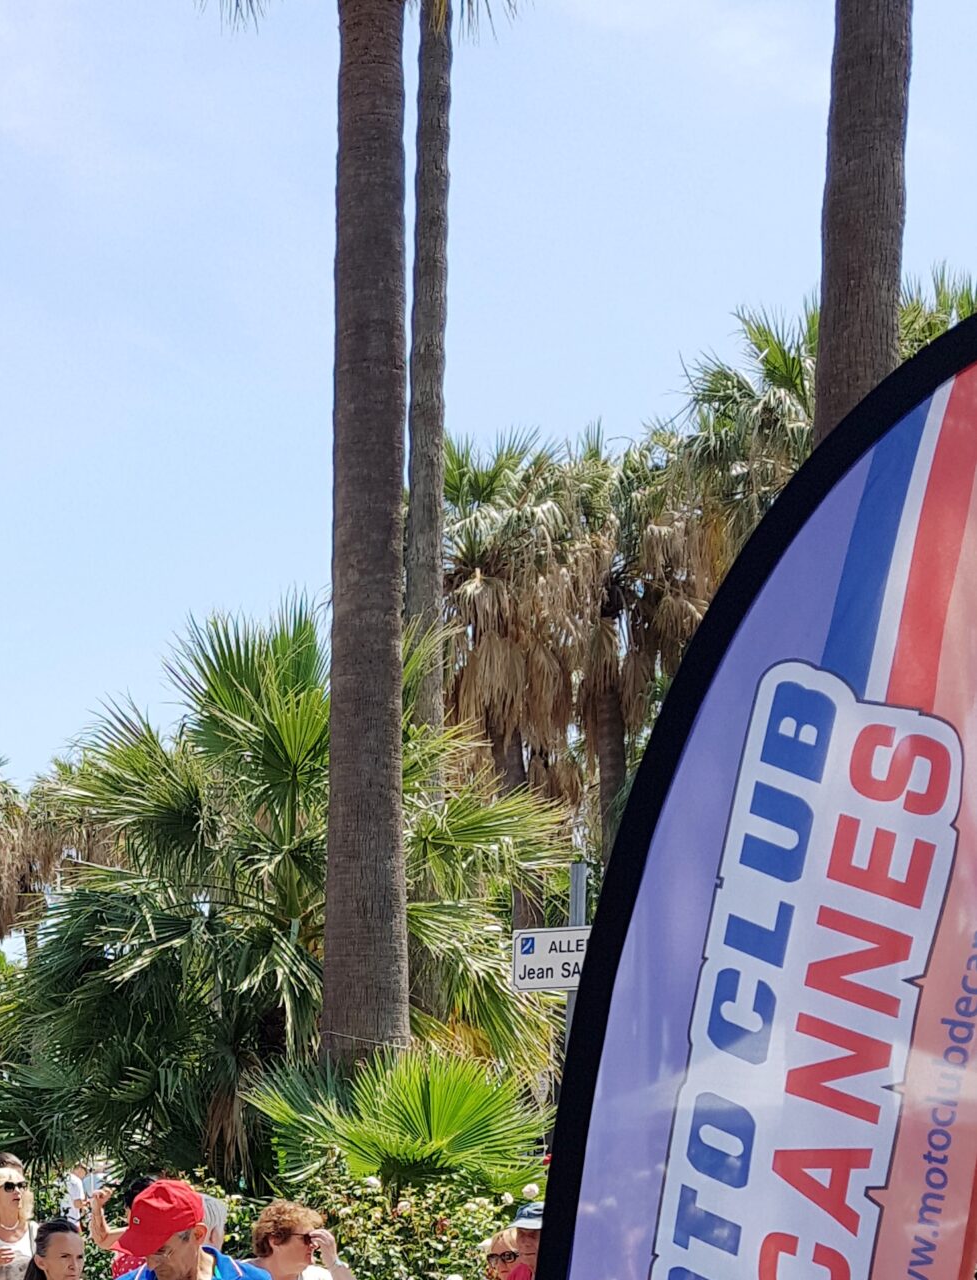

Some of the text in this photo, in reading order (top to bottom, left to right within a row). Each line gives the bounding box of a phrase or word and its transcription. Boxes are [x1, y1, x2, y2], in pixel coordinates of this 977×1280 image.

[707, 680, 837, 1065] CLUB
[548, 939, 584, 954] ALLE
[518, 961, 582, 980] Jean SA
